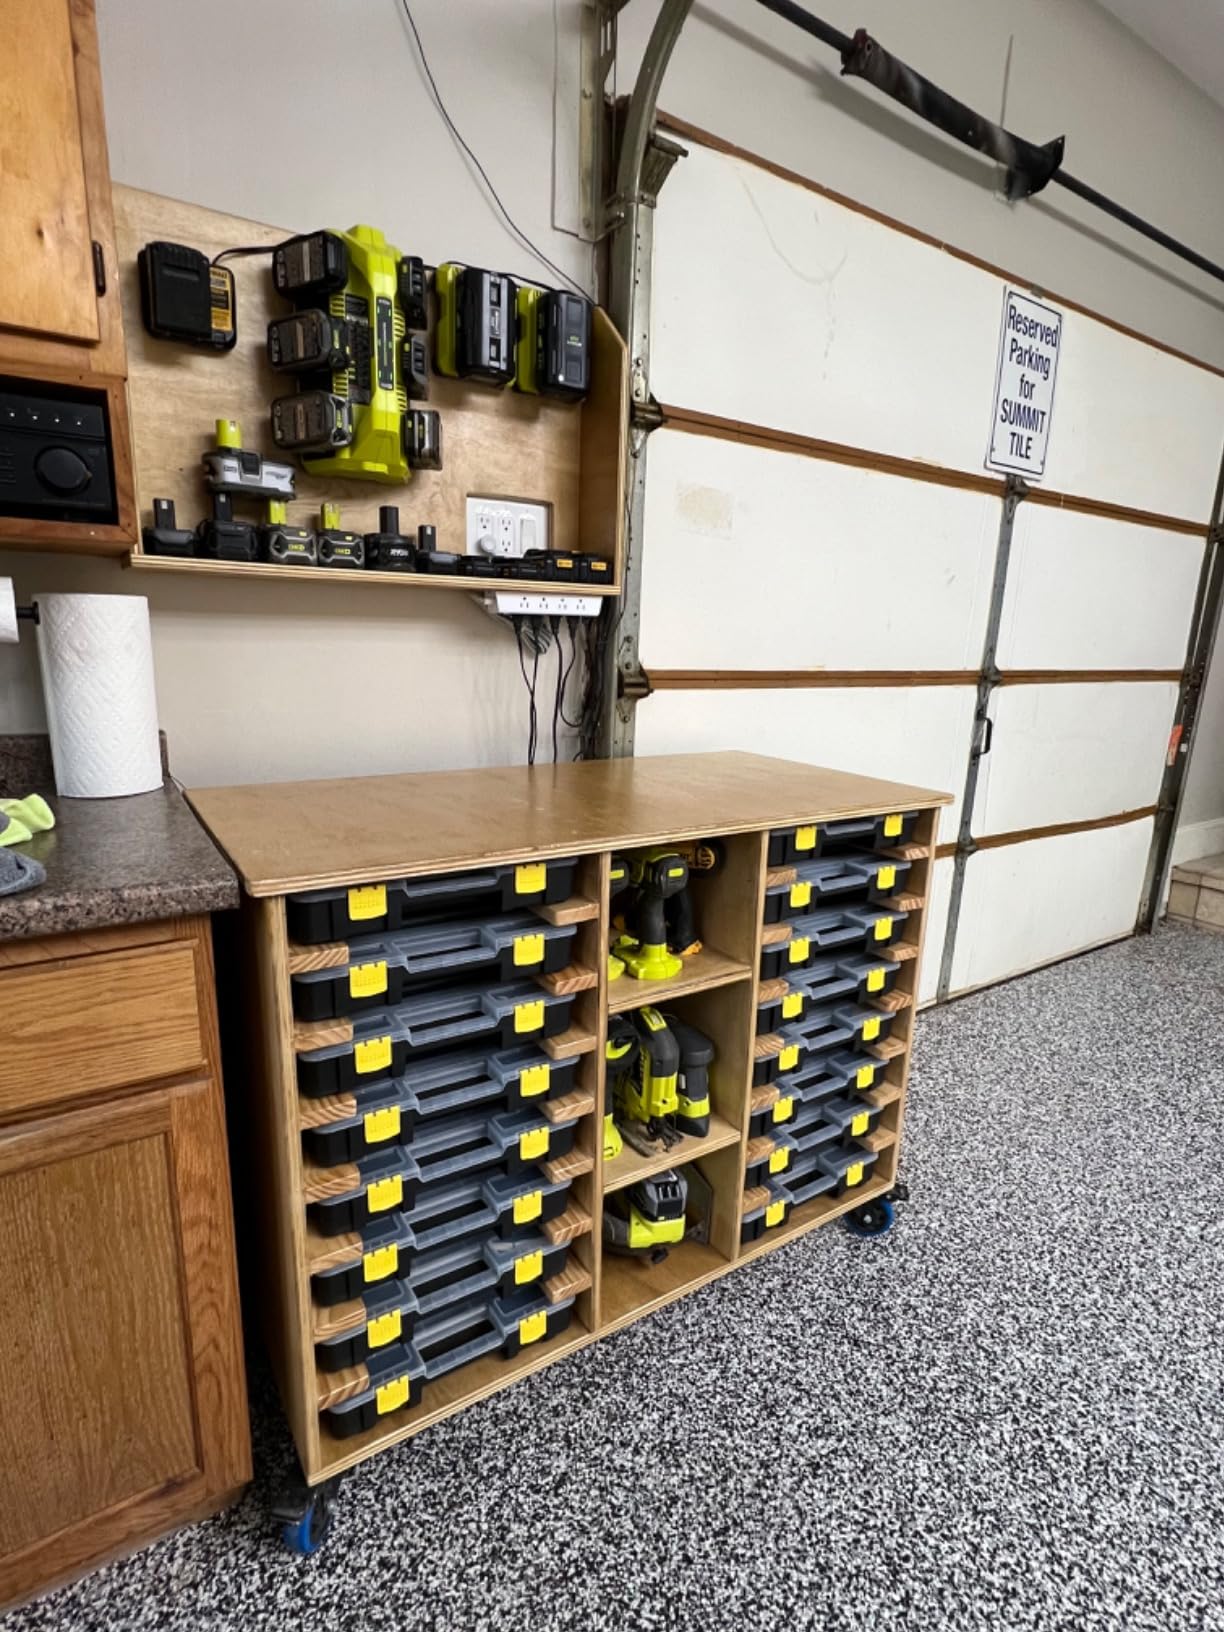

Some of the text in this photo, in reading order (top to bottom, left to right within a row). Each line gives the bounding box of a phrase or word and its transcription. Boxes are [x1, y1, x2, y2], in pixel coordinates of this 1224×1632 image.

[1008, 304, 1059, 348] Reserved
[1009, 338, 1051, 381] Parking
[1018, 374, 1036, 401] for
[1000, 398, 1047, 434] SUMMIT
[1009, 432, 1033, 460] TILE
